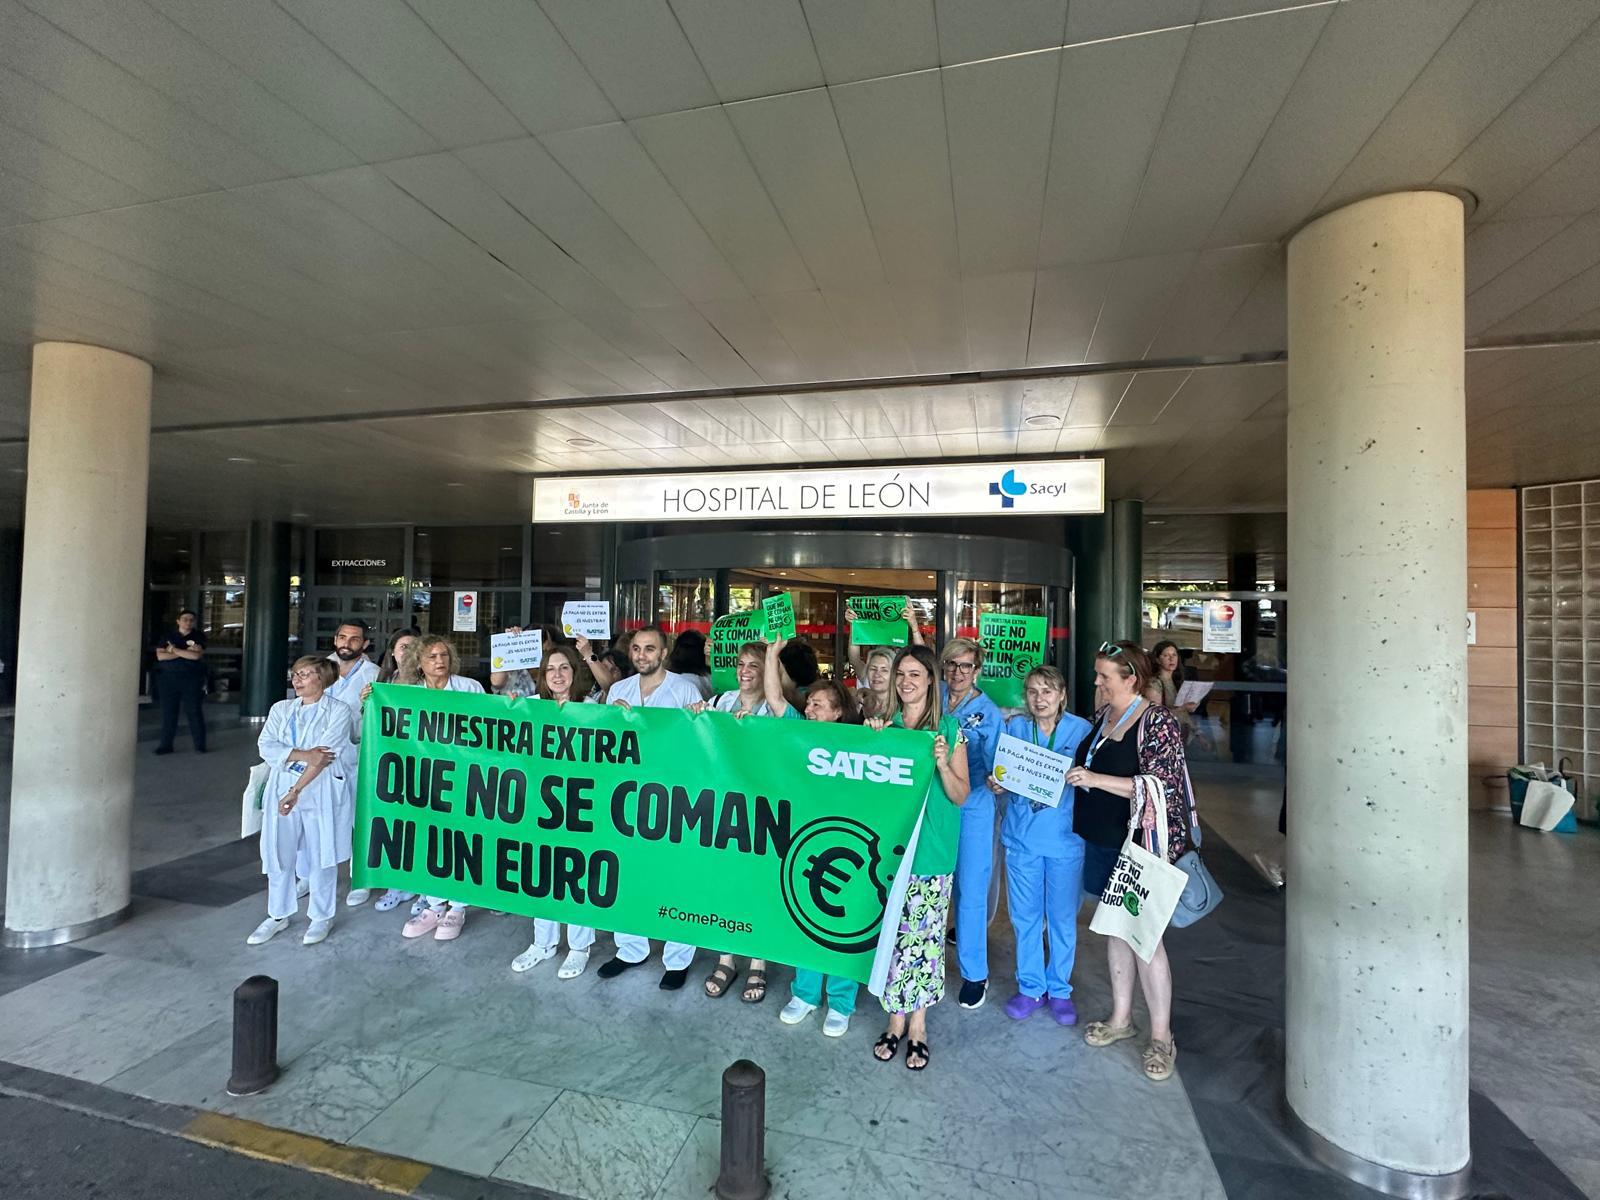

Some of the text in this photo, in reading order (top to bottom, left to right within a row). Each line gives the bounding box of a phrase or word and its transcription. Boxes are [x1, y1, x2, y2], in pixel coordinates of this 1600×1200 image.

[663, 473, 930, 513] HOSPITAL DE LEÓN
[1029, 483, 1066, 497] Sacyl
[331, 559, 387, 567] EXTRACCIONES
[864, 599, 880, 611] UN
[715, 617, 750, 629] QUE NO
[713, 629, 761, 641] SE COMAN
[984, 624, 1026, 639] QUE NO
[713, 642, 739, 655] NI UN
[982, 638, 1041, 653] SE COMAN
[997, 652, 1014, 665] UN
[981, 665, 1012, 679] EURO
[381, 706, 641, 765] DE NUESTRA EXTRA
[806, 748, 914, 786] SATSE
[998, 745, 1006, 753] LA
[1006, 748, 1024, 760] PAGA
[1025, 756, 1035, 764] NO
[1043, 764, 1064, 775] EXTRA
[1027, 783, 1055, 799] SATSE
[376, 752, 792, 860] QUE NO SE COMAN
[367, 816, 620, 909] NI UN EURO
[1115, 859, 1141, 880] UE NO
[1113, 882, 1128, 895] UN
[1117, 872, 1150, 900] COMAN
[657, 905, 753, 934] #ComePagas
